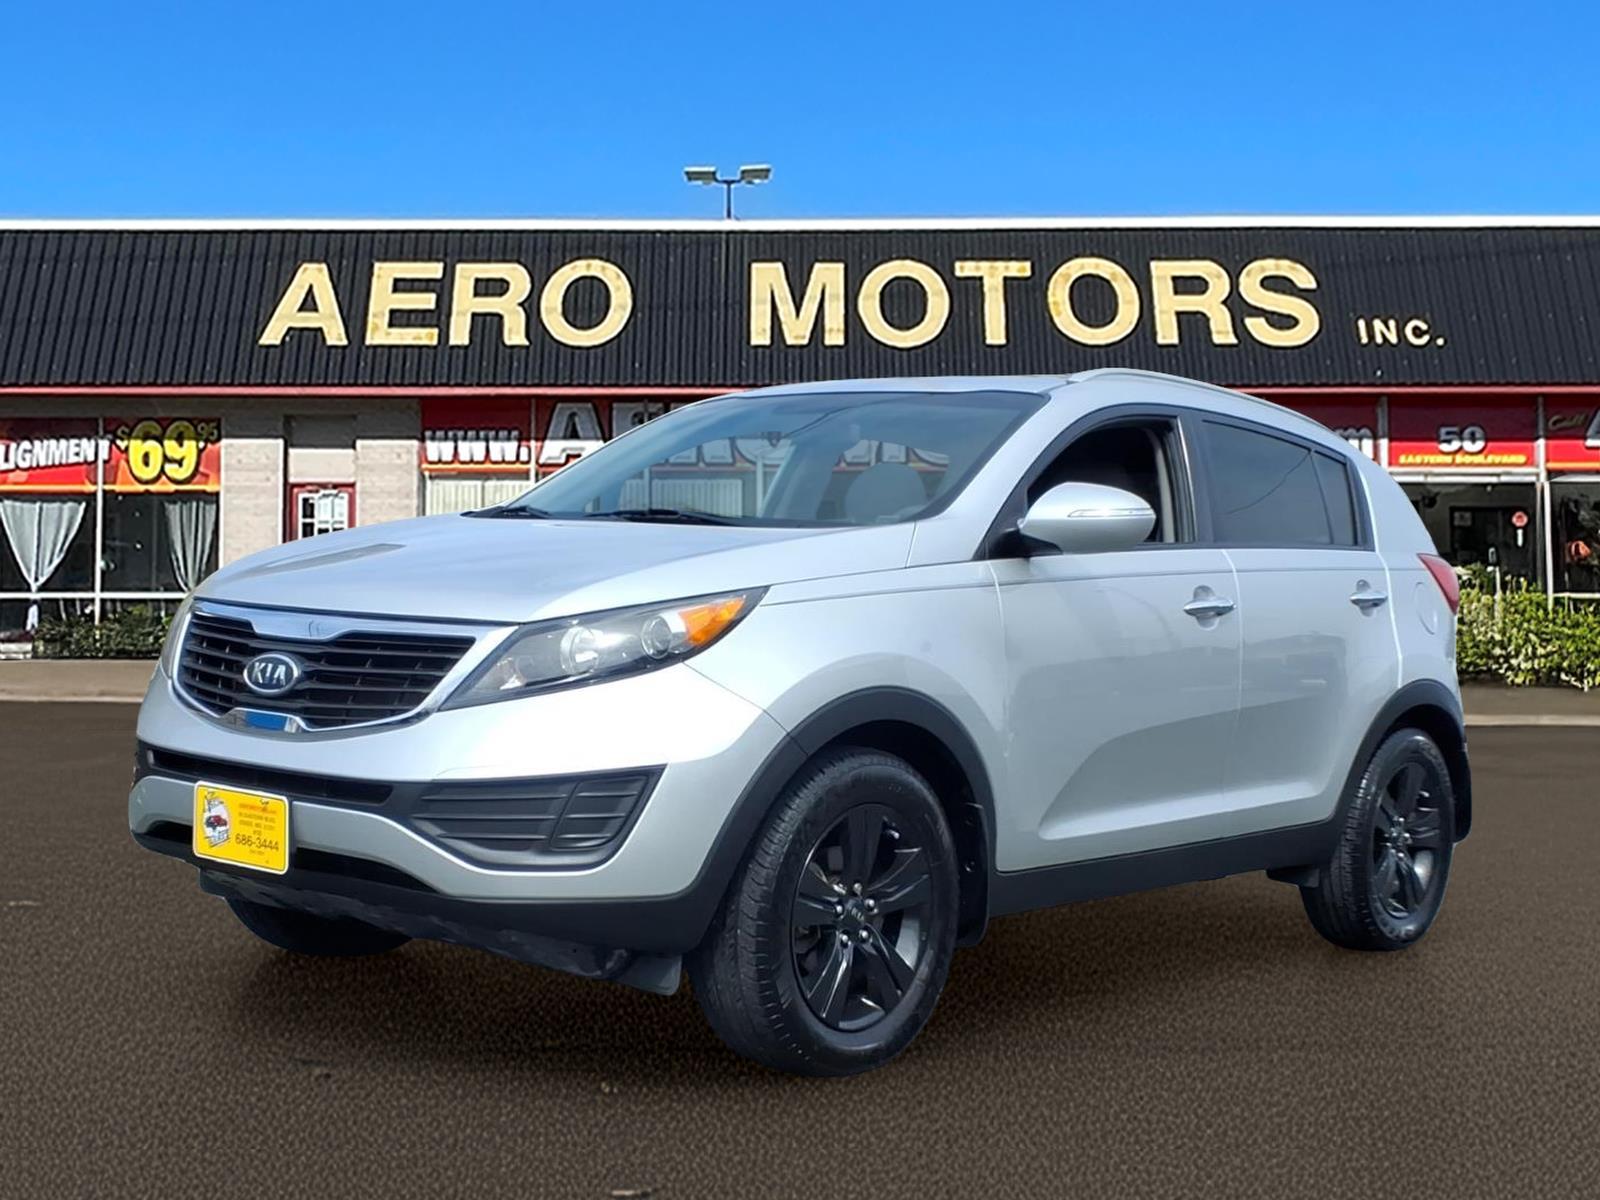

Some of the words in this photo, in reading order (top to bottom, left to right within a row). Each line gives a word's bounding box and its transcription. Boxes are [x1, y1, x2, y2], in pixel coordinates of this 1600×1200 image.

[258, 258, 633, 348] AERO
[749, 257, 1321, 349] MOTORS
[1356, 317, 1447, 347] INC.
[1438, 425, 1486, 453] 50
[1455, 454, 1528, 464] BOULEVARD
[251, 662, 286, 685] KIA
